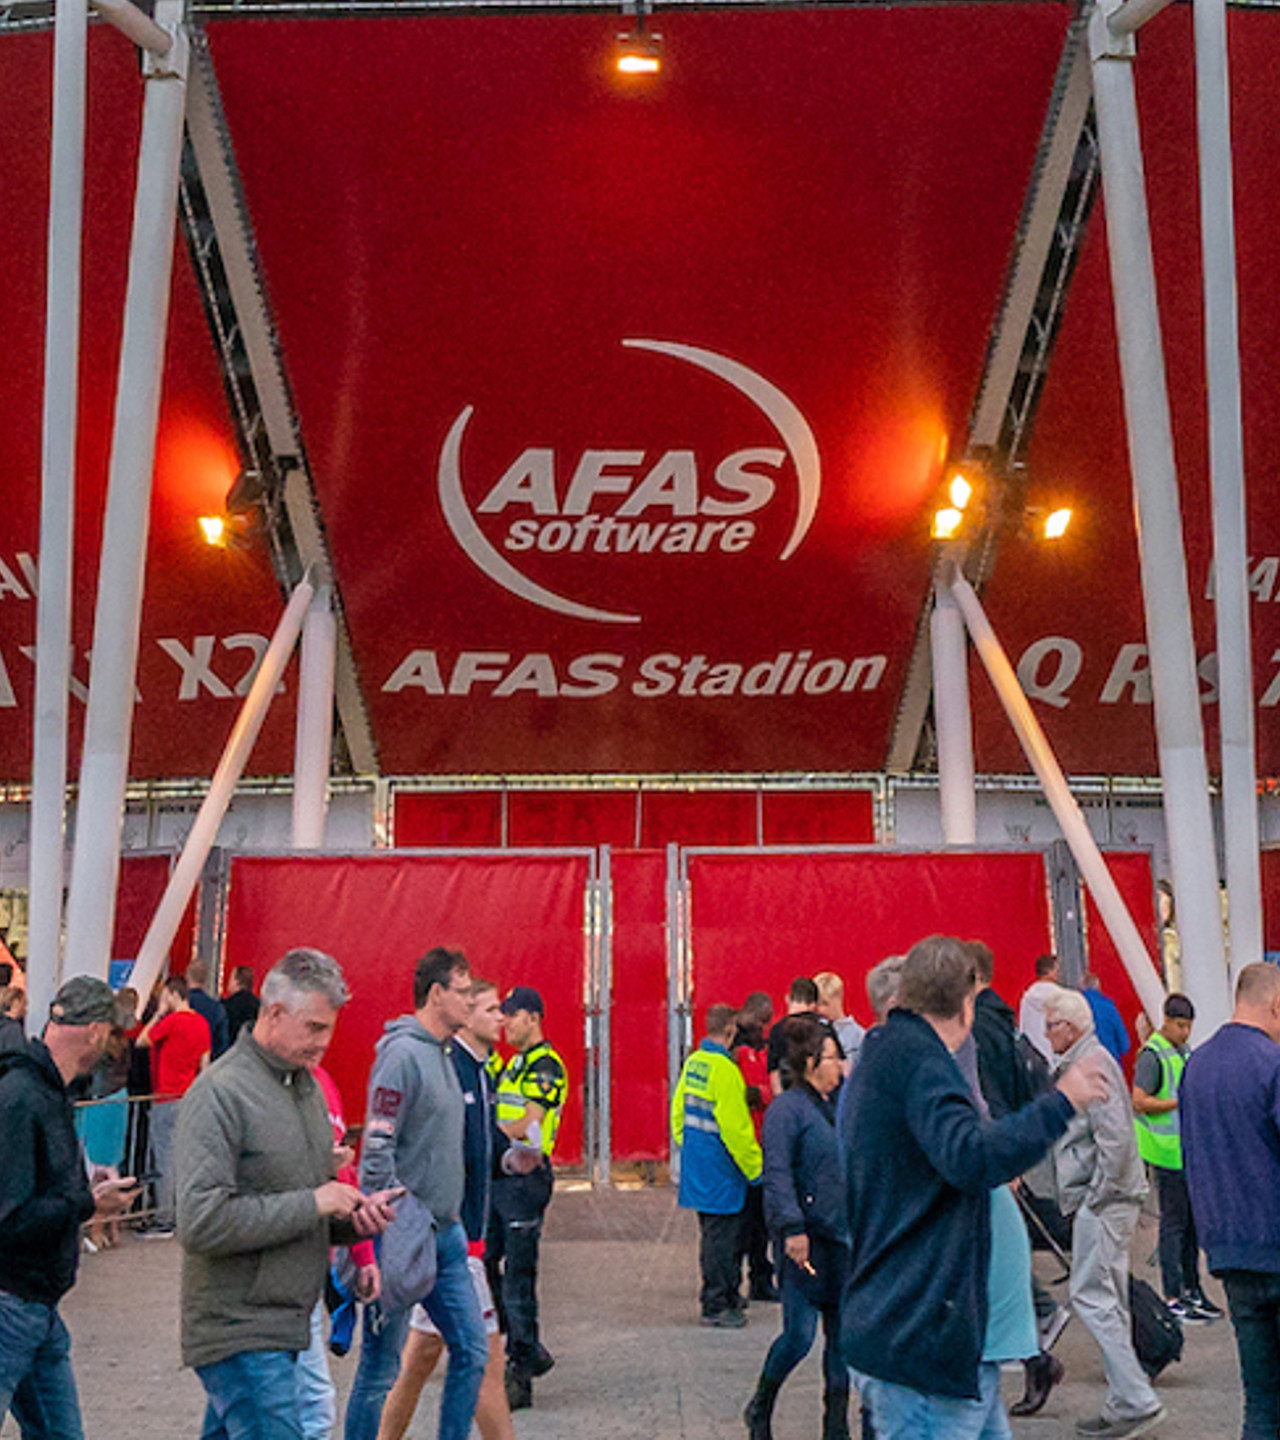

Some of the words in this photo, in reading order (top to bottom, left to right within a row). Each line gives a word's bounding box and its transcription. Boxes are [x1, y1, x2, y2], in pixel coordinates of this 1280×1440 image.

[476, 447, 787, 517] AFAS
[504, 514, 757, 553] software
[381, 649, 623, 698] AFAS
[631, 650, 888, 698] Stadion
